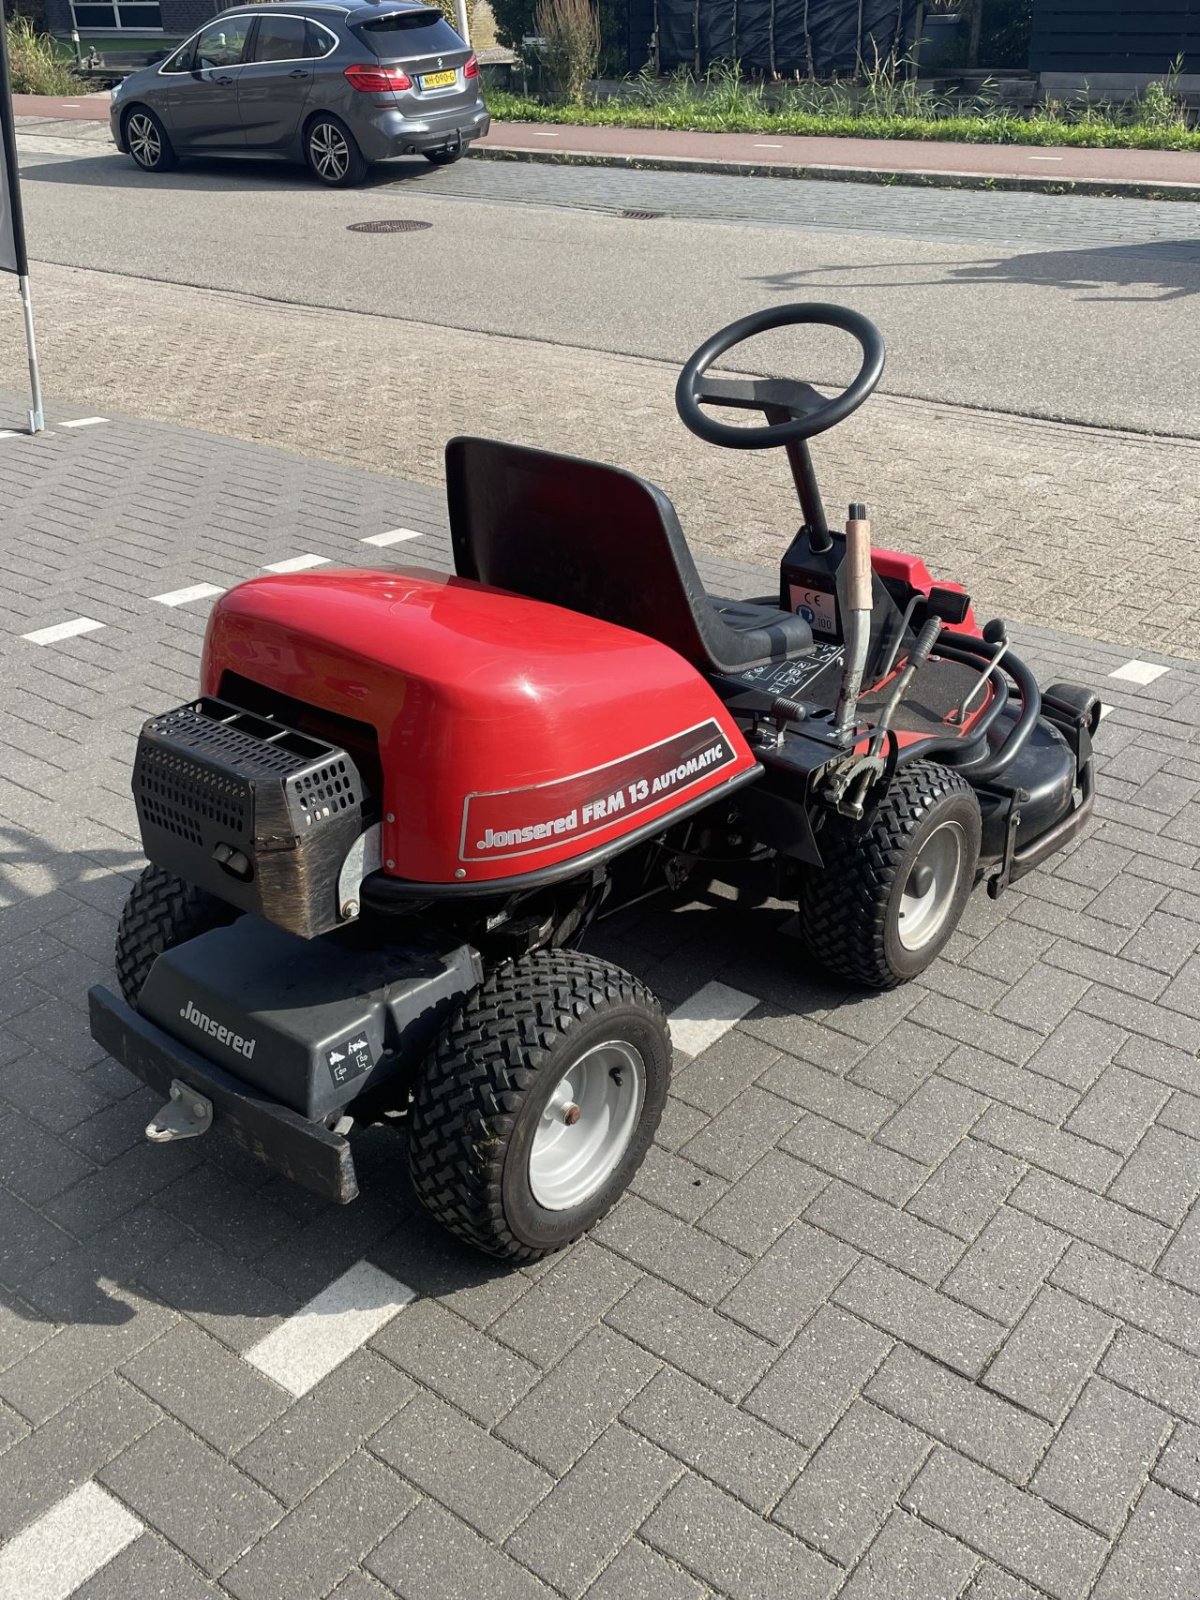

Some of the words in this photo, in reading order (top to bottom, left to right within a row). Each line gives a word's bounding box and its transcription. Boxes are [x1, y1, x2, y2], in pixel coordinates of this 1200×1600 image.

[581, 790, 626, 825] FRM
[628, 779, 650, 804] 13
[651, 743, 723, 794] AUTOMATIC
